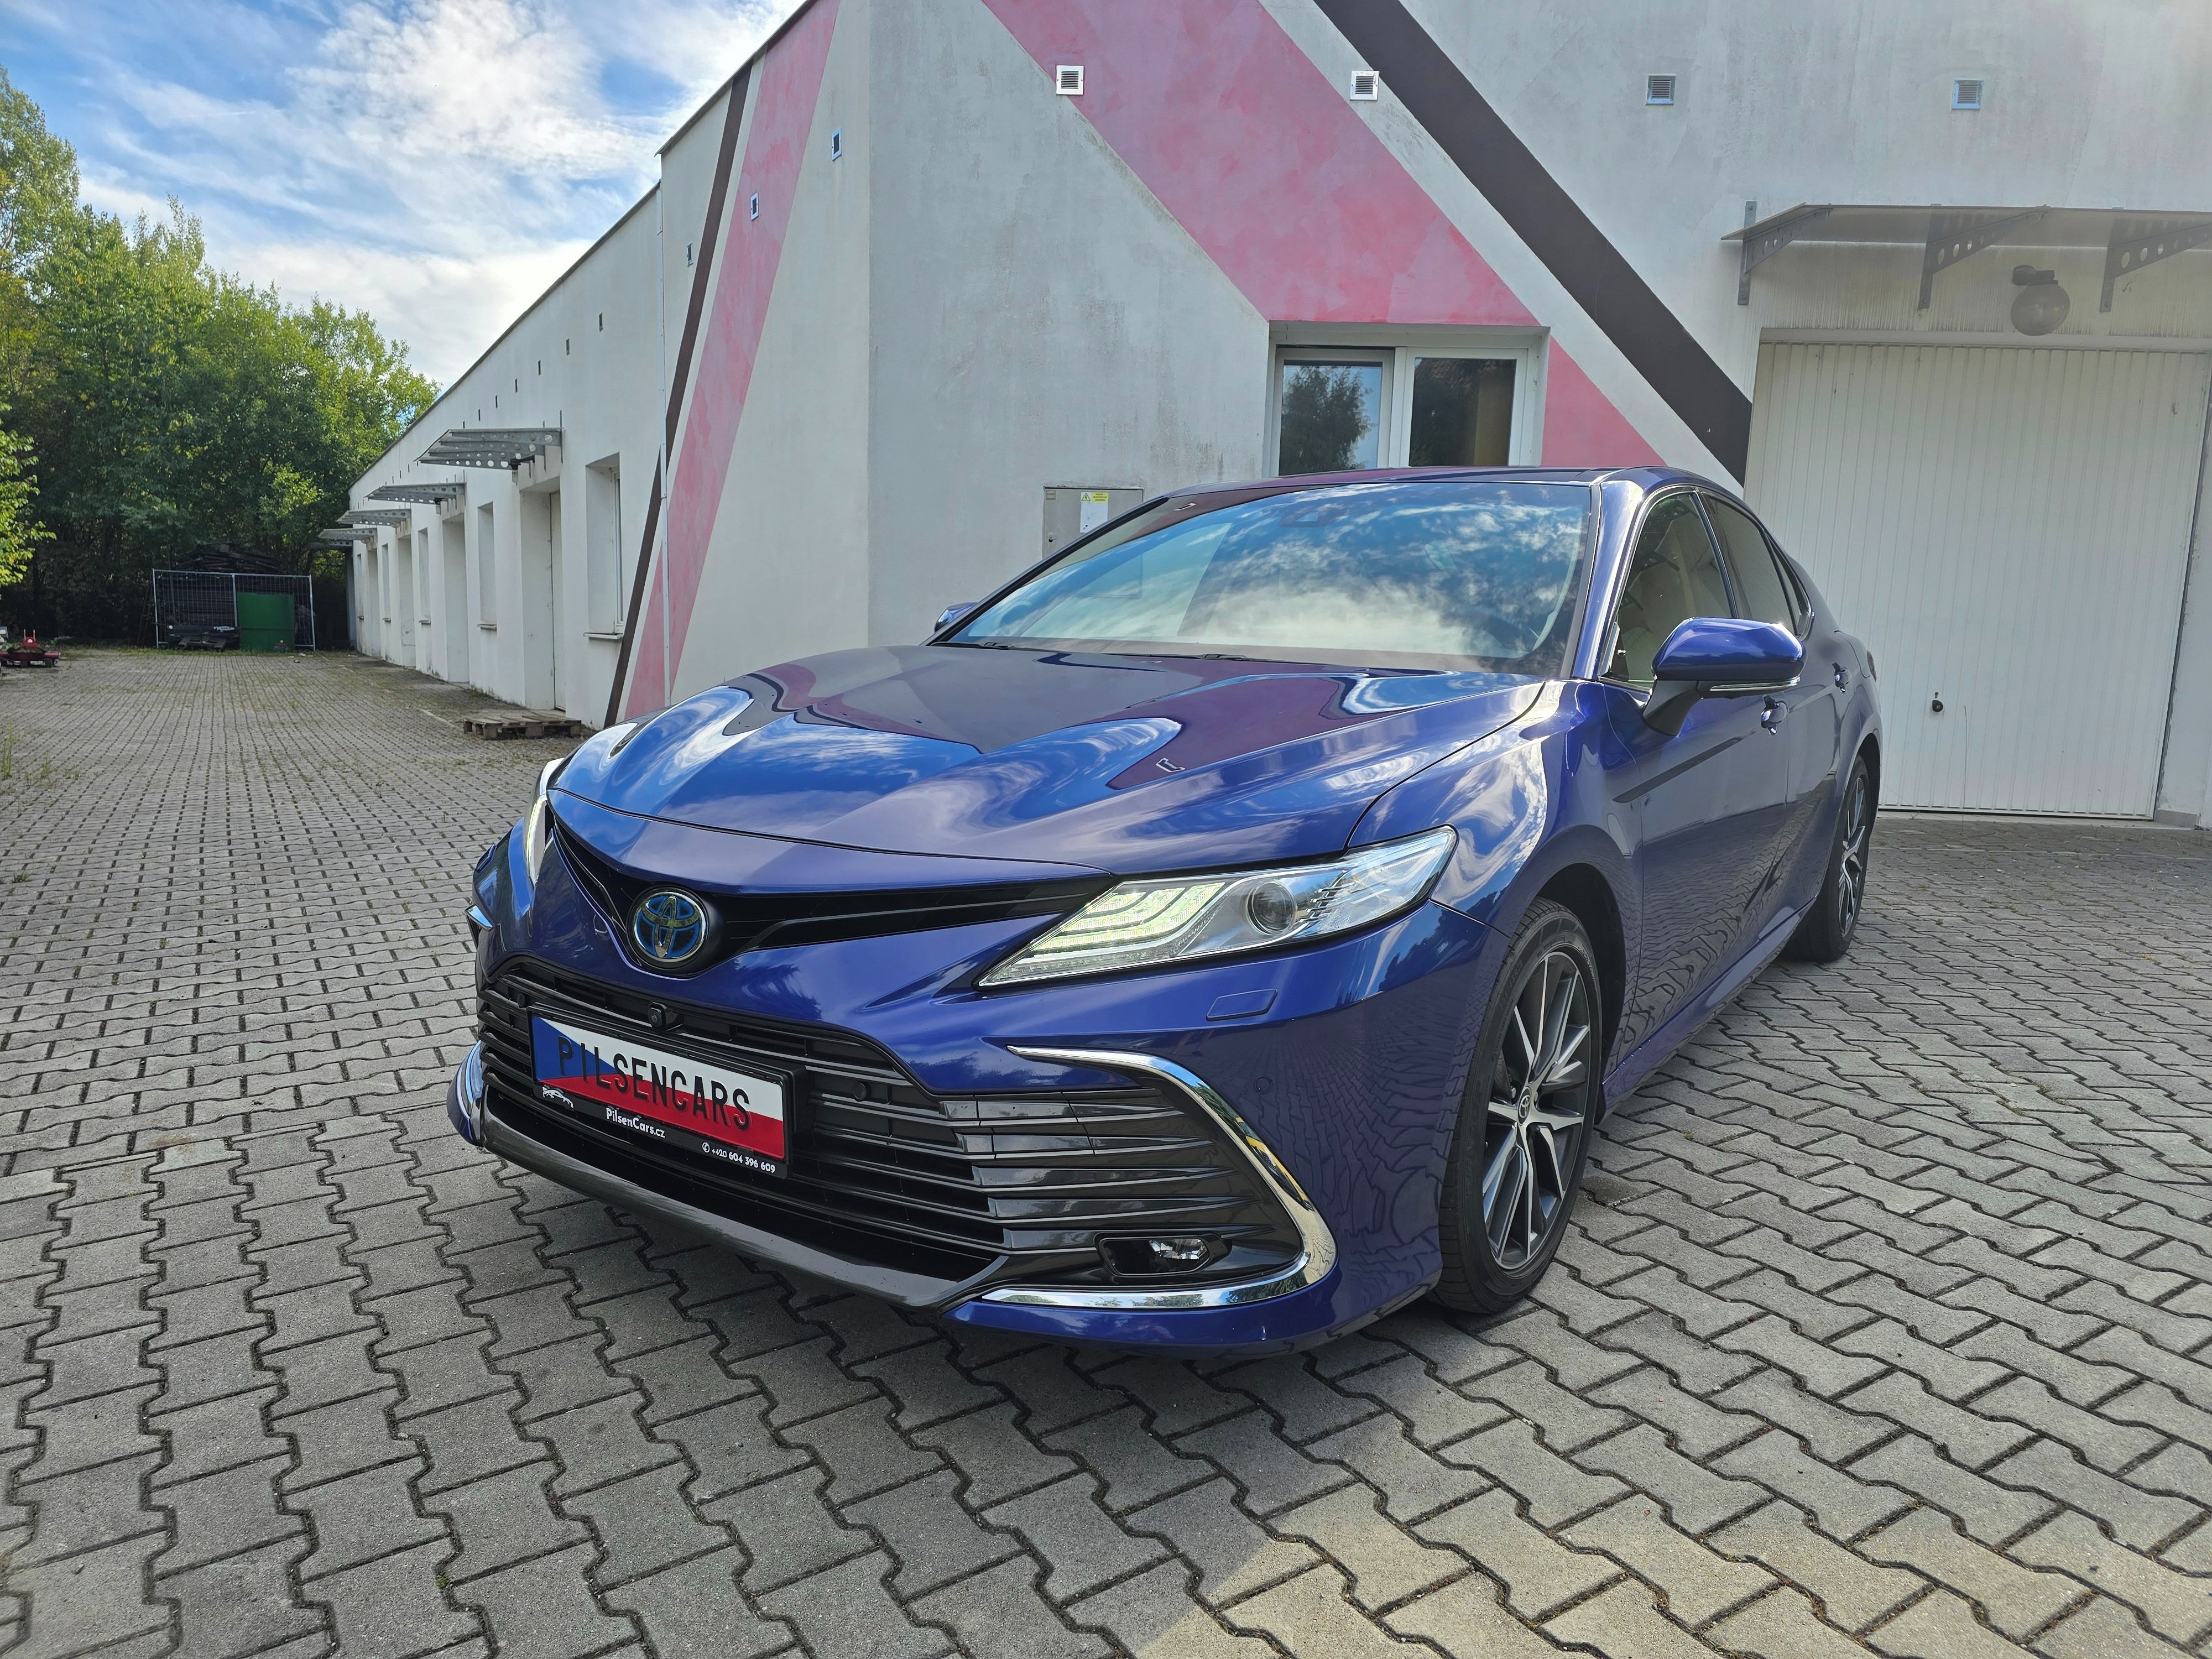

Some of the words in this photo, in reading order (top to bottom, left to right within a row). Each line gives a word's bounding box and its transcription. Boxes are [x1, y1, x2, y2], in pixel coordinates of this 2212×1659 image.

[558, 1036, 750, 1130] PILSENCARS
[606, 1107, 665, 1138] PilsenCars.cz
[712, 1149, 727, 1158] +420
[728, 1151, 743, 1163] 604
[745, 1156, 759, 1168] 396
[760, 1162, 776, 1173] 609
